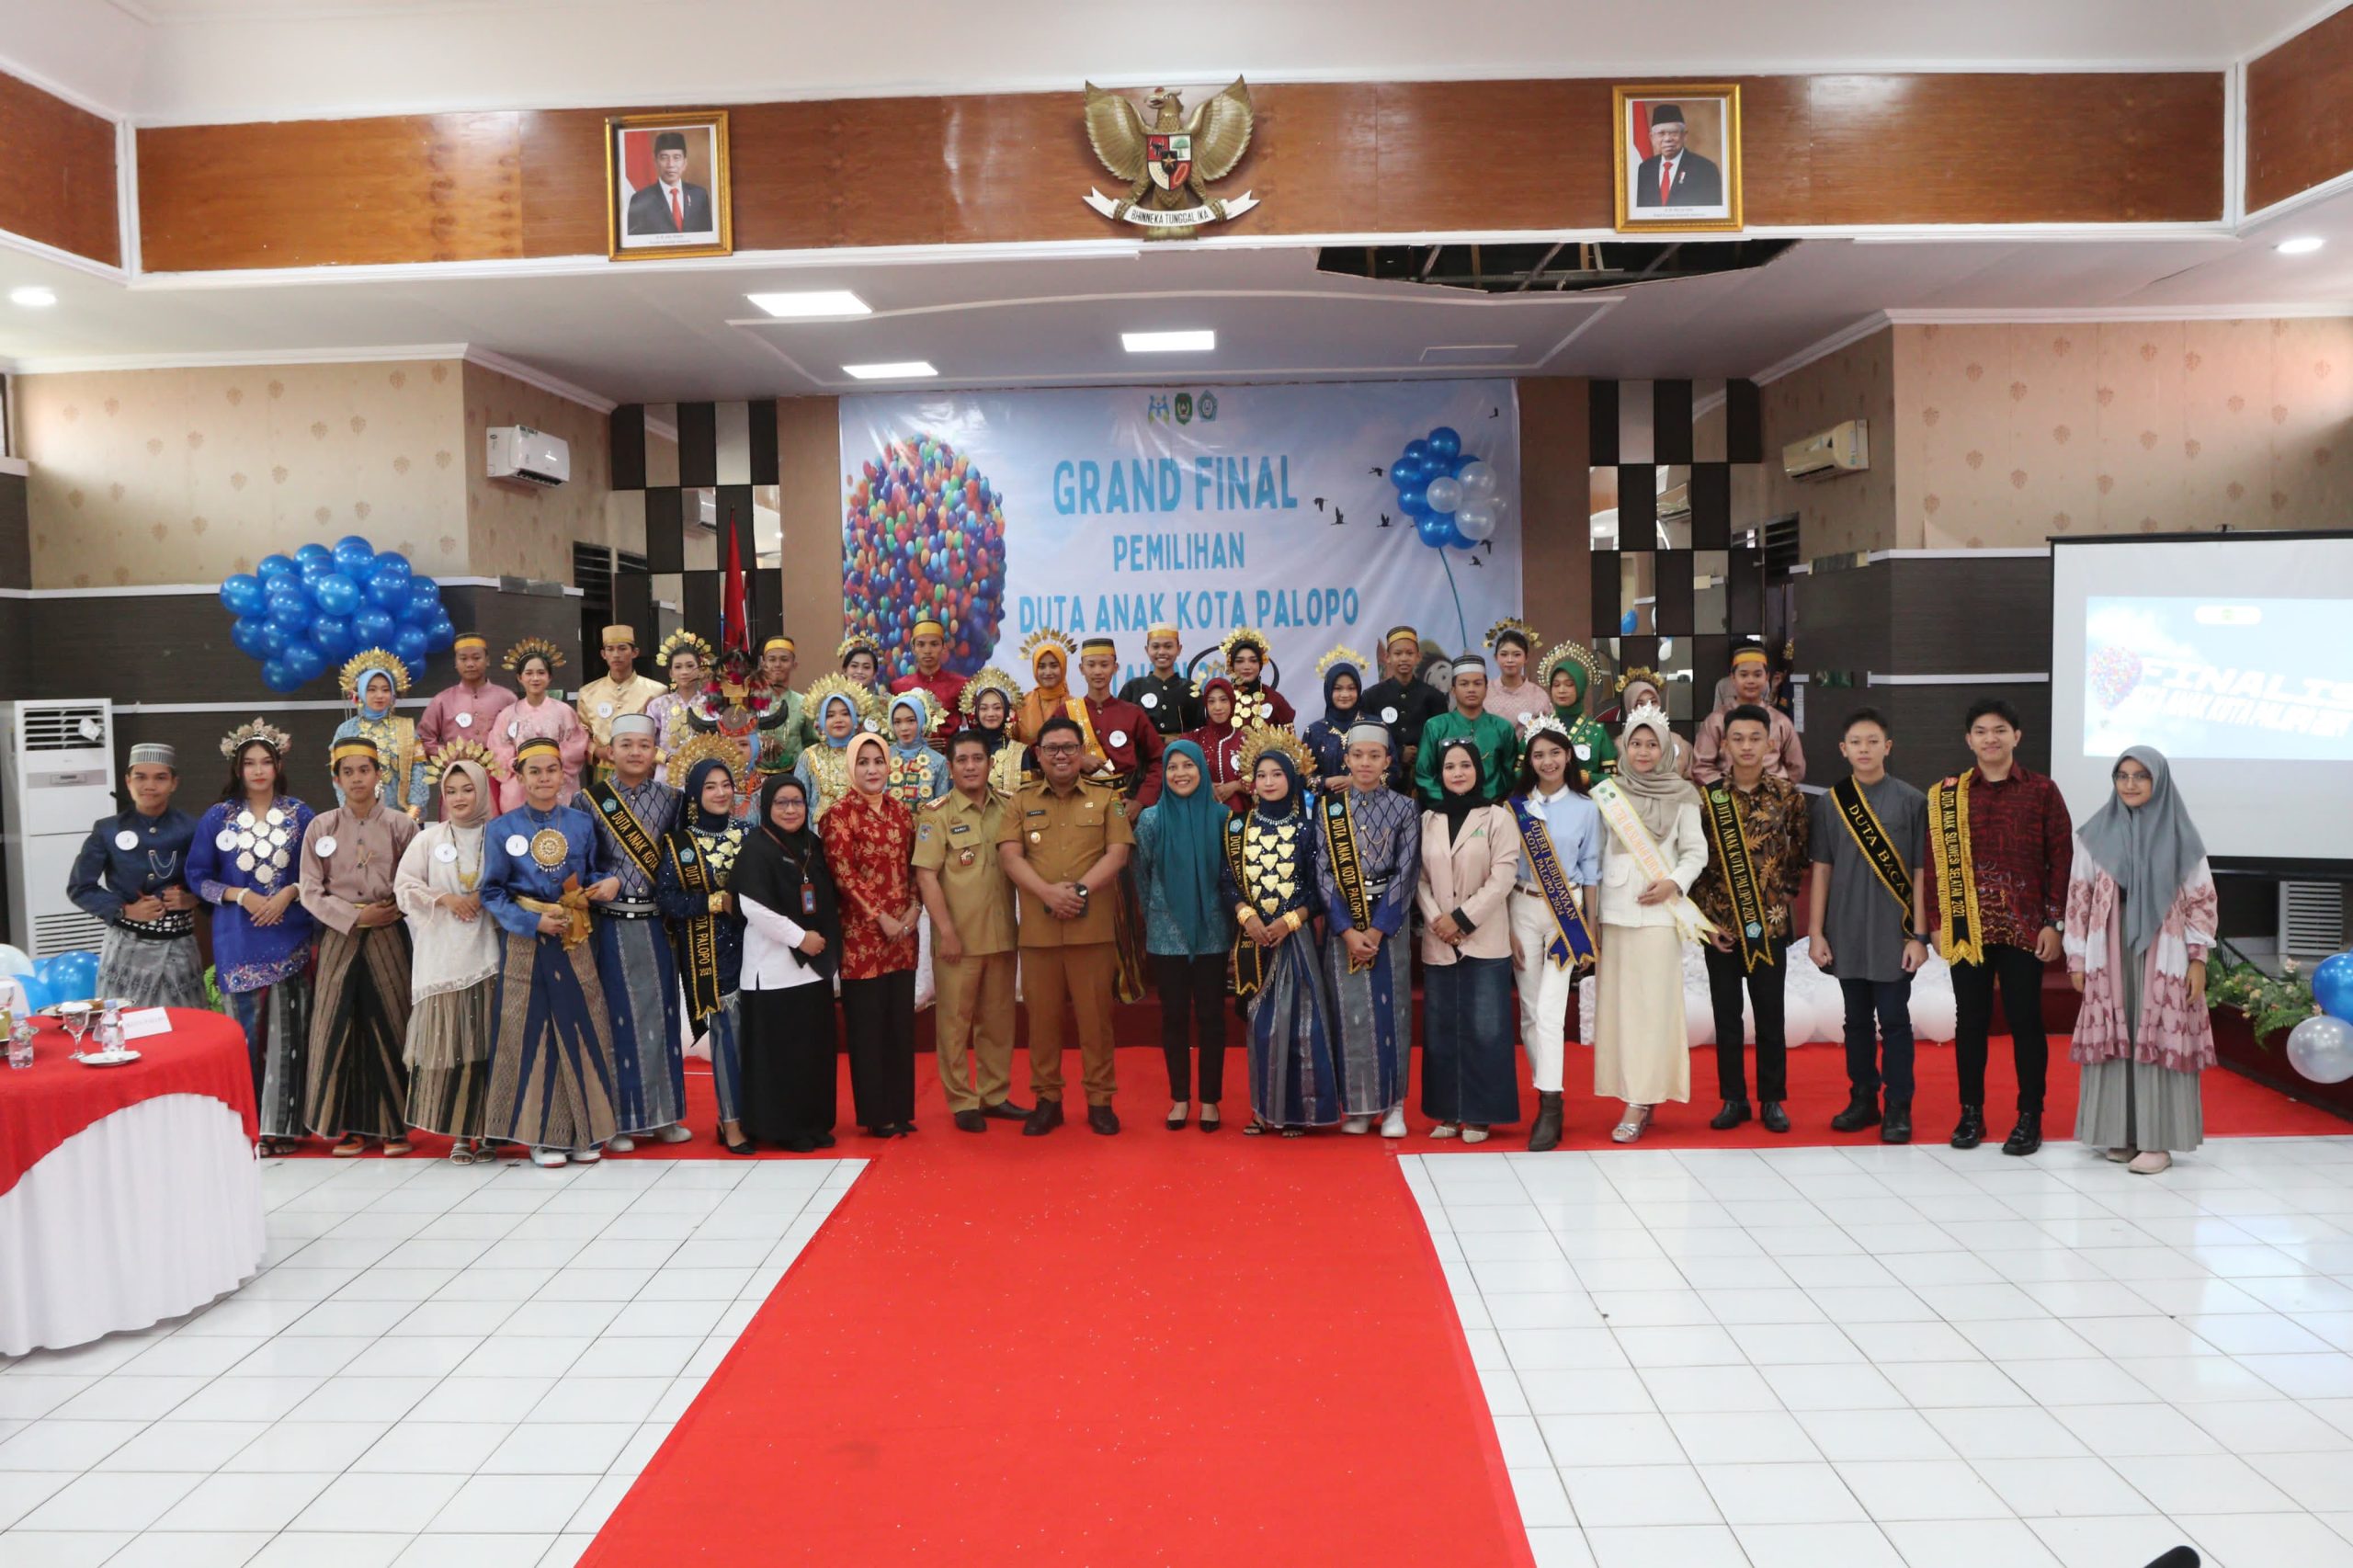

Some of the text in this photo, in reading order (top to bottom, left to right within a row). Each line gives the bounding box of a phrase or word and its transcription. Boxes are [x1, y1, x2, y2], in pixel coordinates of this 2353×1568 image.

[1131, 209, 1209, 224] BHINNEKA TUNGGAL IKA
[1052, 454, 1298, 515] GRAND FINAL
[1113, 531, 1245, 572] PEMILIHAN
[1018, 586, 1359, 634] DUTA ANAK KOTA PALOPO
[1331, 818, 1347, 839] DUTA
[1715, 802, 1733, 825] DUTA
[611, 811, 660, 871] DUTA ANAK KOTA
[1230, 835, 1242, 857] DUTA
[1336, 841, 1352, 864] ANAK
[1722, 827, 1740, 851] ANAK
[1848, 804, 1905, 893] DUTA BACA
[1941, 790, 1966, 917] DUTA ANAK SULAWESI SELATAN 2021
[1341, 865, 1357, 886] KOTA
[1525, 831, 1540, 857] KOTA
[1536, 857, 1555, 894] PALOPO
[1529, 820, 1578, 920] PUTERI KEBUDAYAAN
[1728, 850, 1746, 875] KOTA
[685, 865, 711, 965] DUTA OTA PALOPO
[1347, 887, 1362, 919] PALOPO
